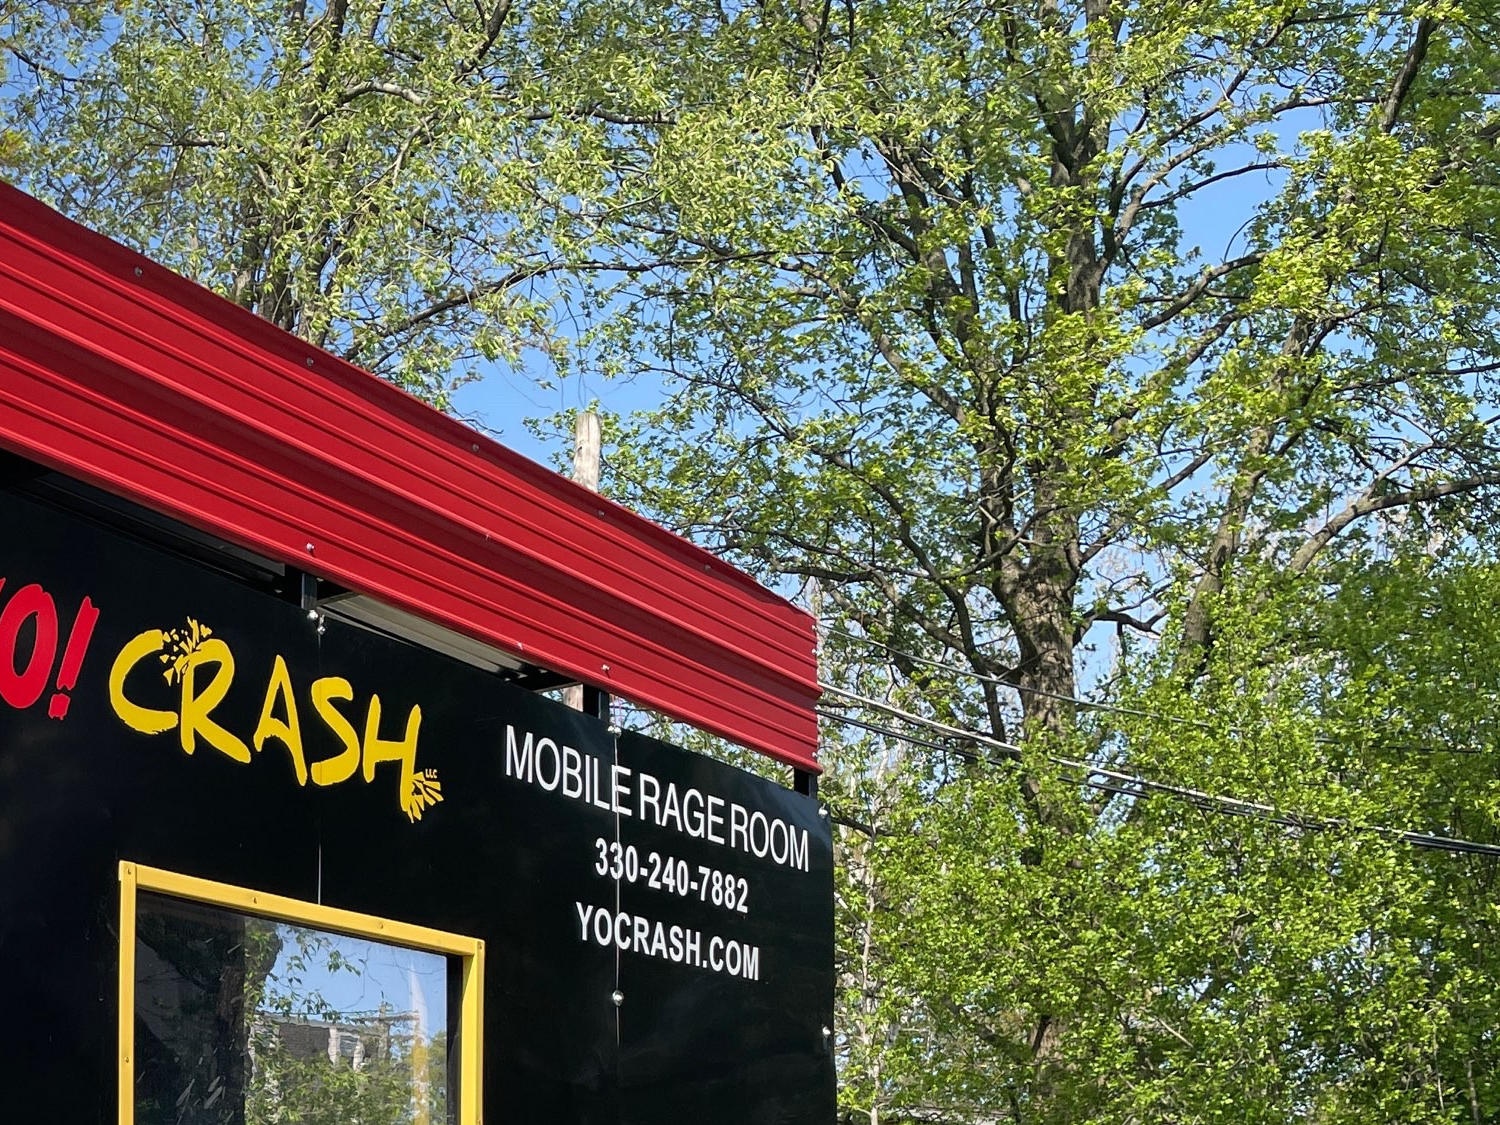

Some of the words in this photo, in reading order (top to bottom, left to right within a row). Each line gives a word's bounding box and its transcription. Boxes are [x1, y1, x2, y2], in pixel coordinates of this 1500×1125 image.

[109, 616, 443, 822] CRASH
[425, 768, 438, 779] LLC
[507, 725, 632, 816] MOBILE
[640, 773, 724, 844] RAGE
[731, 804, 808, 872] ROOM
[596, 838, 747, 913] 330-240-7882
[576, 902, 758, 980] YOCRASH.COM
